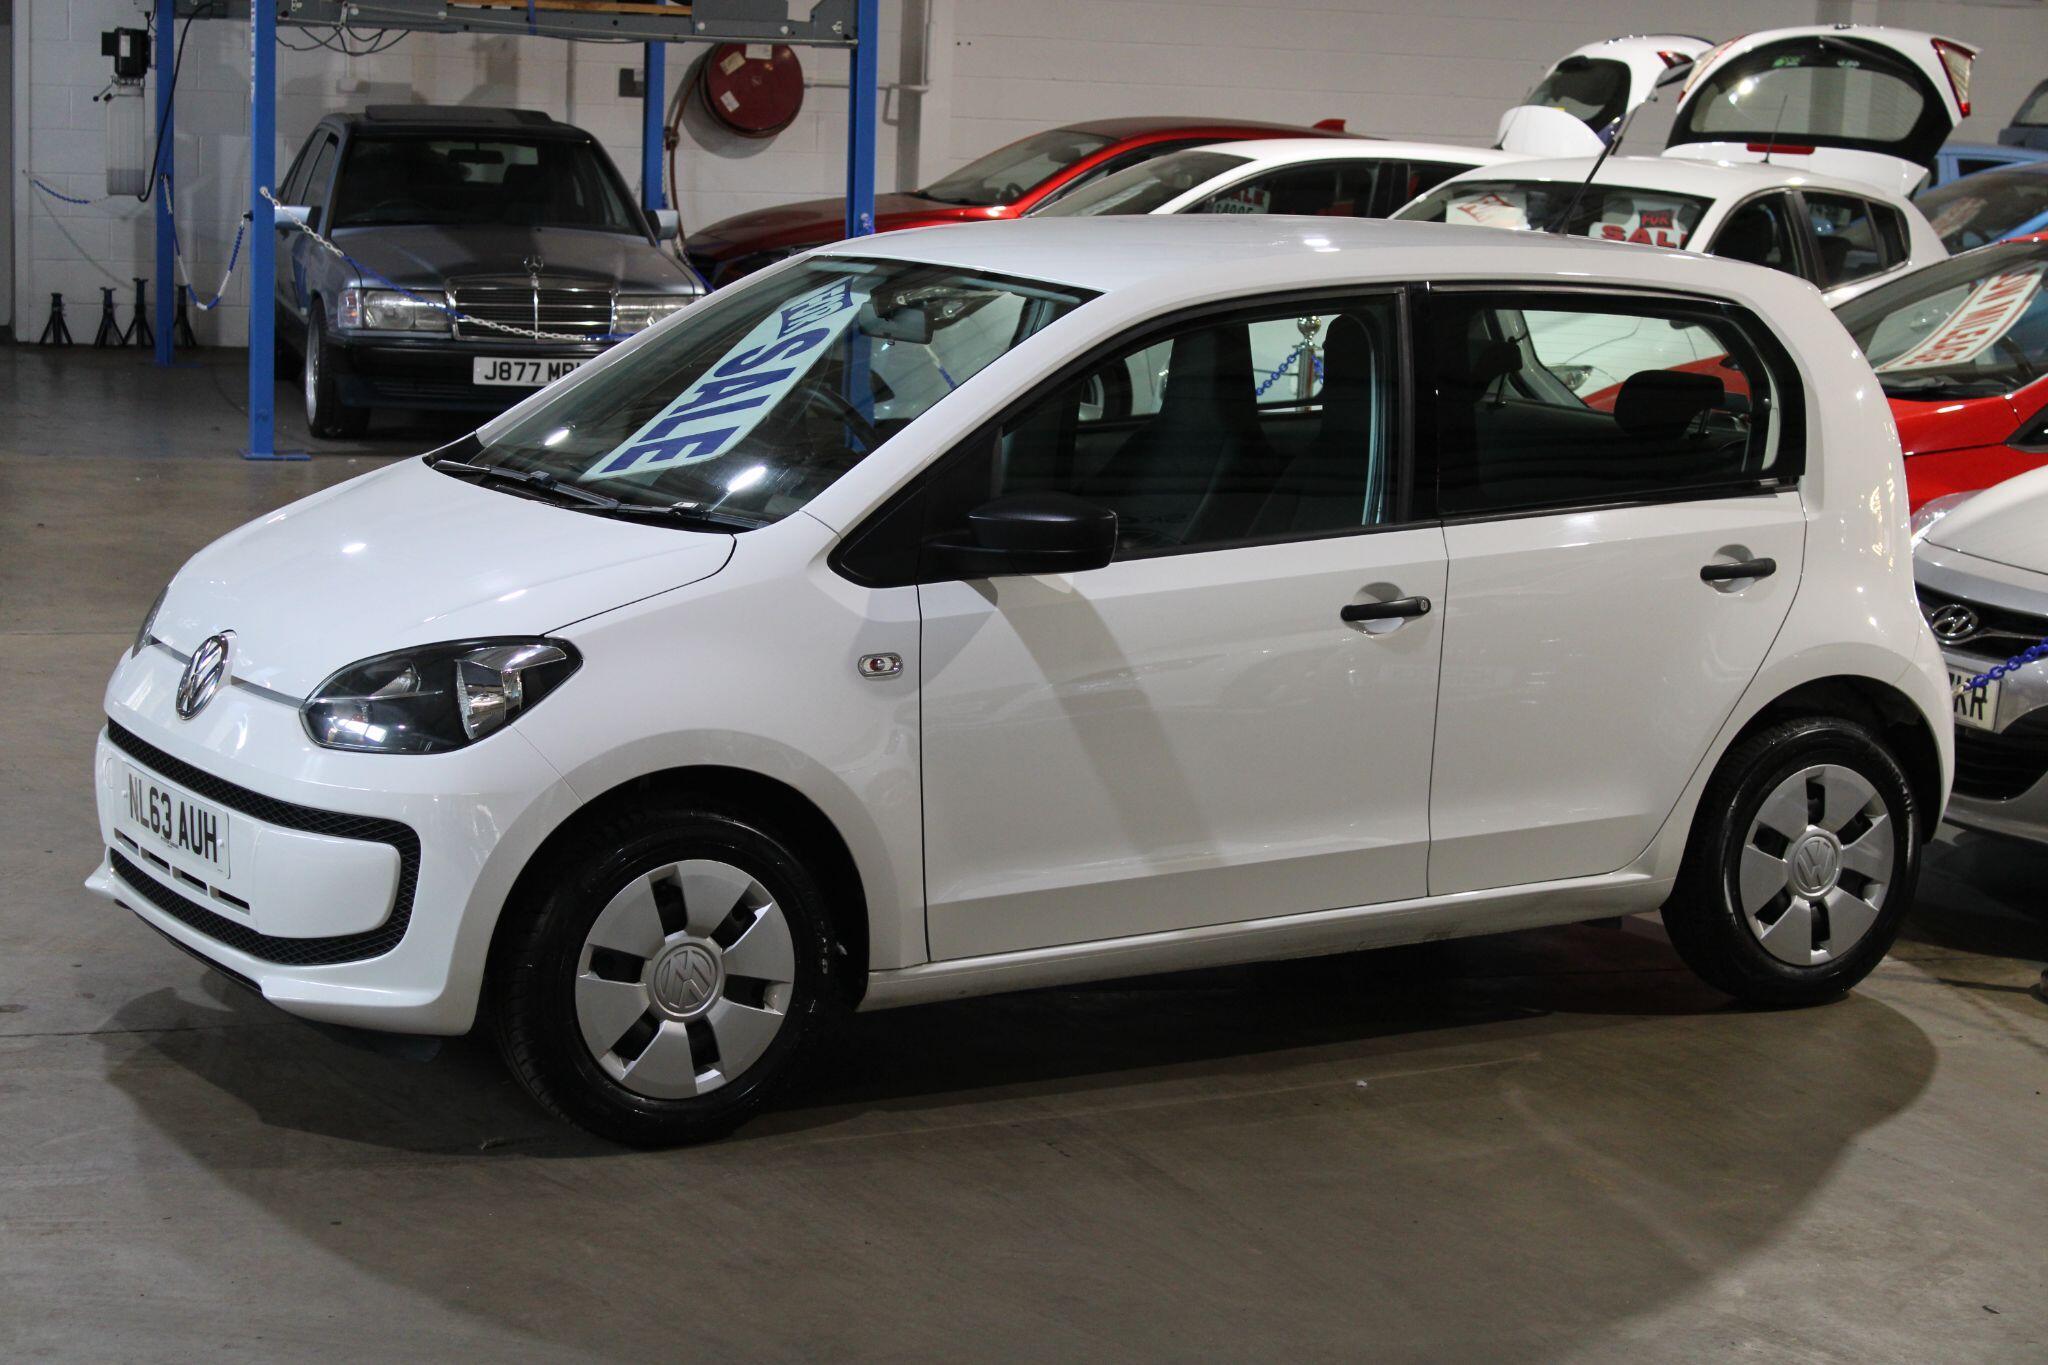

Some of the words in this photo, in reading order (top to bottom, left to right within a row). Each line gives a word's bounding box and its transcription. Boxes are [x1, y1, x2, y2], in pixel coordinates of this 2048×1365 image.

[778, 276, 854, 340] FOR
[484, 361, 541, 382] J877
[600, 328, 830, 474] SALE
[129, 772, 172, 840] NL63
[179, 801, 217, 863] AUH
